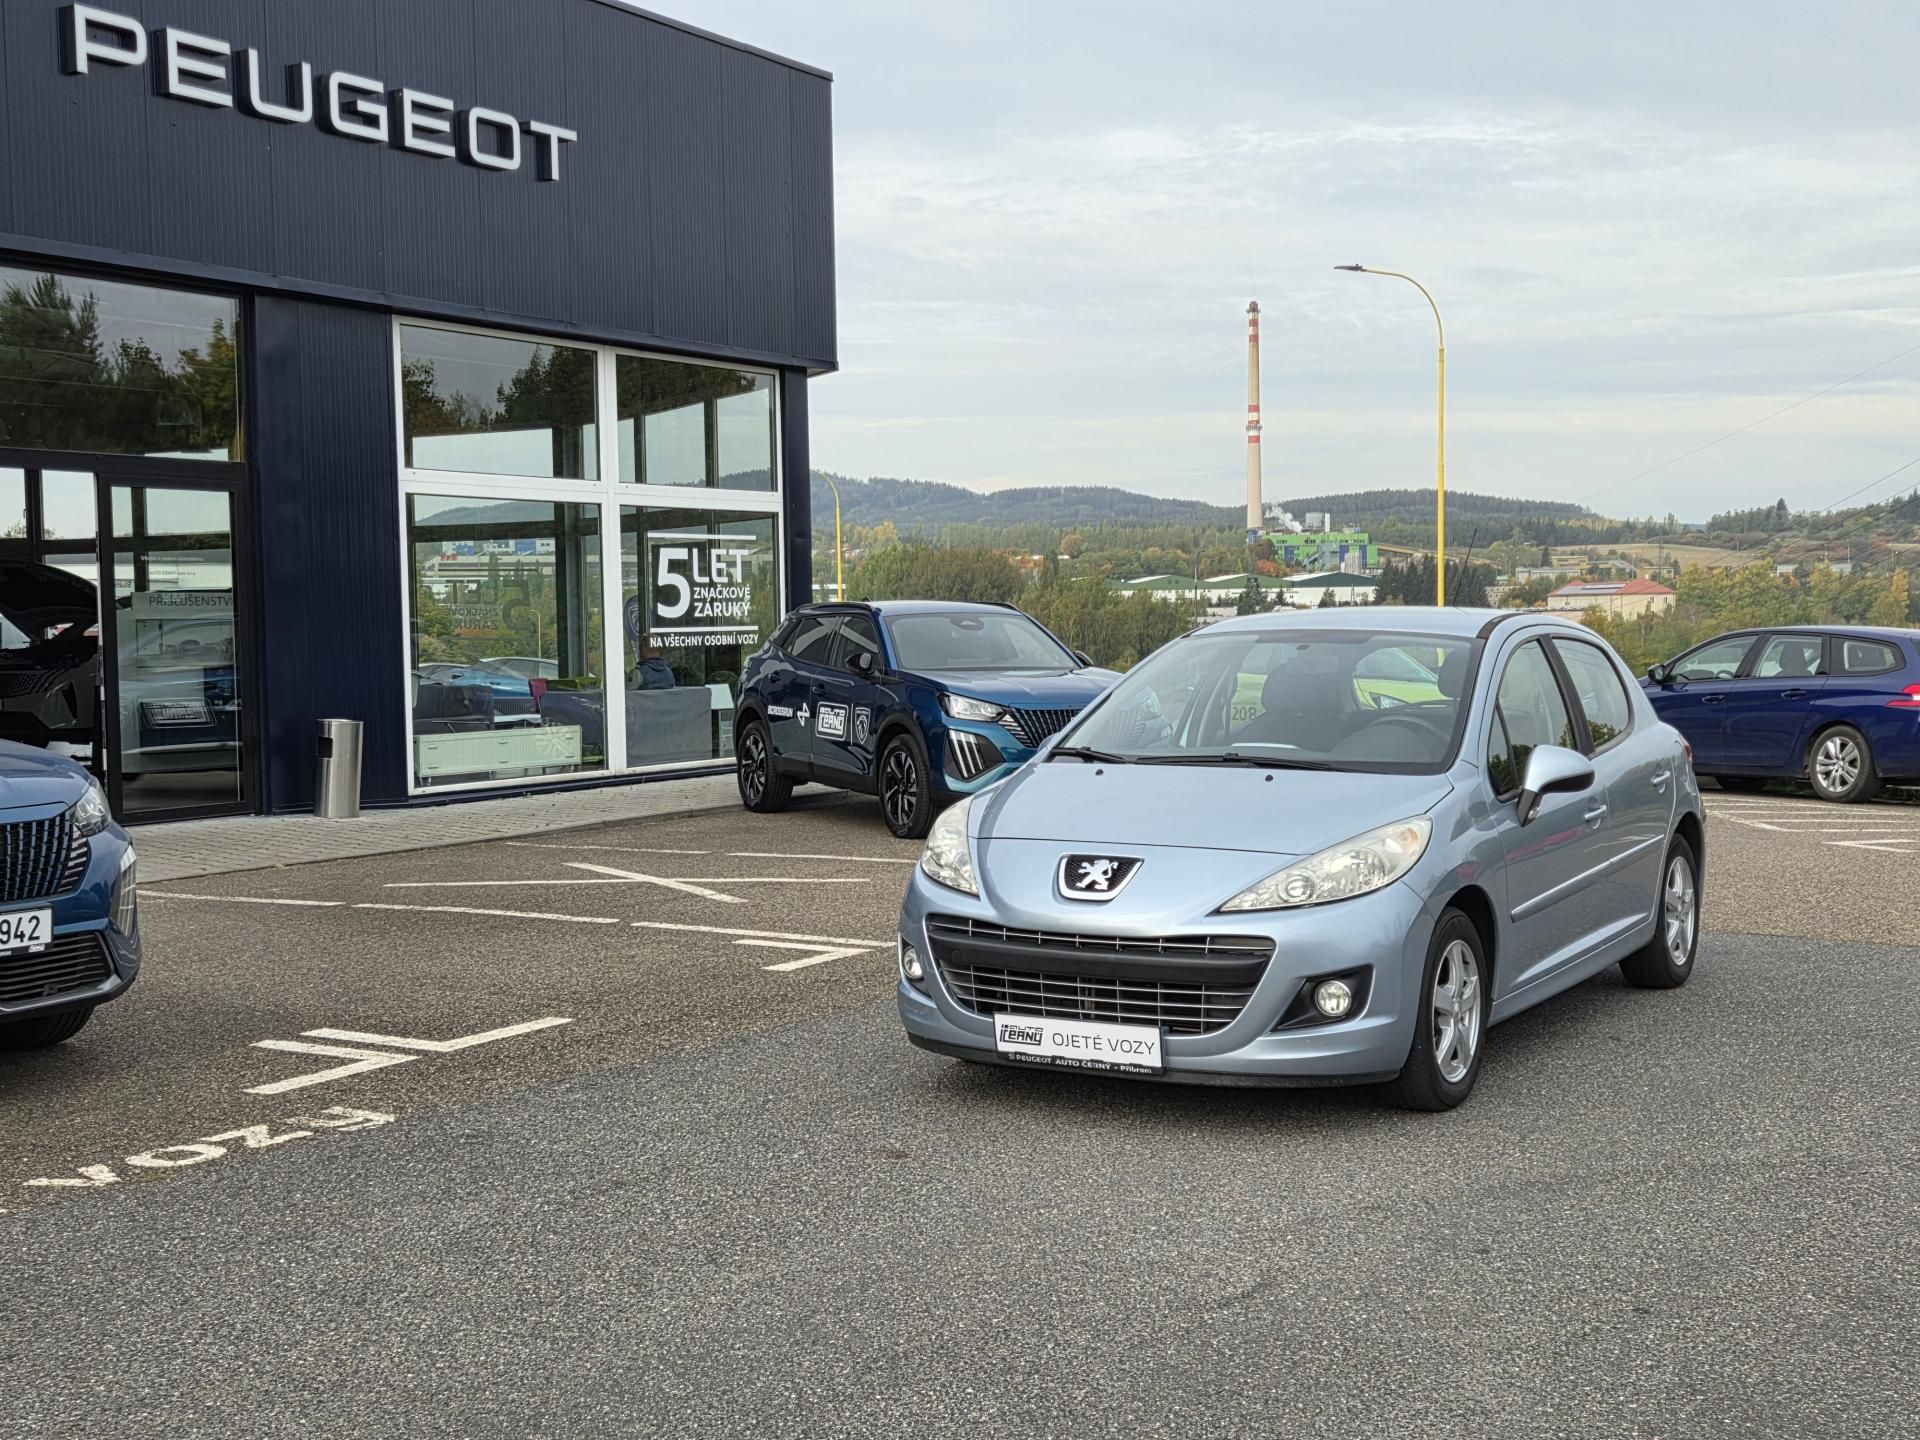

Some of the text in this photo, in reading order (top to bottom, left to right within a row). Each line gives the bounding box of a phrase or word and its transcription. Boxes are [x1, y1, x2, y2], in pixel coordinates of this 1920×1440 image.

[66, 3, 577, 181] PEUGEOT
[657, 548, 749, 618] 5 LET
[693, 584, 751, 599] ZNAČKOVÉ
[694, 598, 750, 617] ZÁRUKY
[650, 632, 759, 647] NA VŠECHNY OSOBNÍ VOZY
[0, 915, 41, 945] 942
[1052, 1033, 1155, 1055] OJETÉ VOZY
[1016, 1054, 1052, 1064] PEUGEOT
[1055, 1058, 1080, 1067] AUTO
[1081, 1060, 1112, 1070] ČERNÝ
[1120, 1065, 1152, 1074] Příbram
